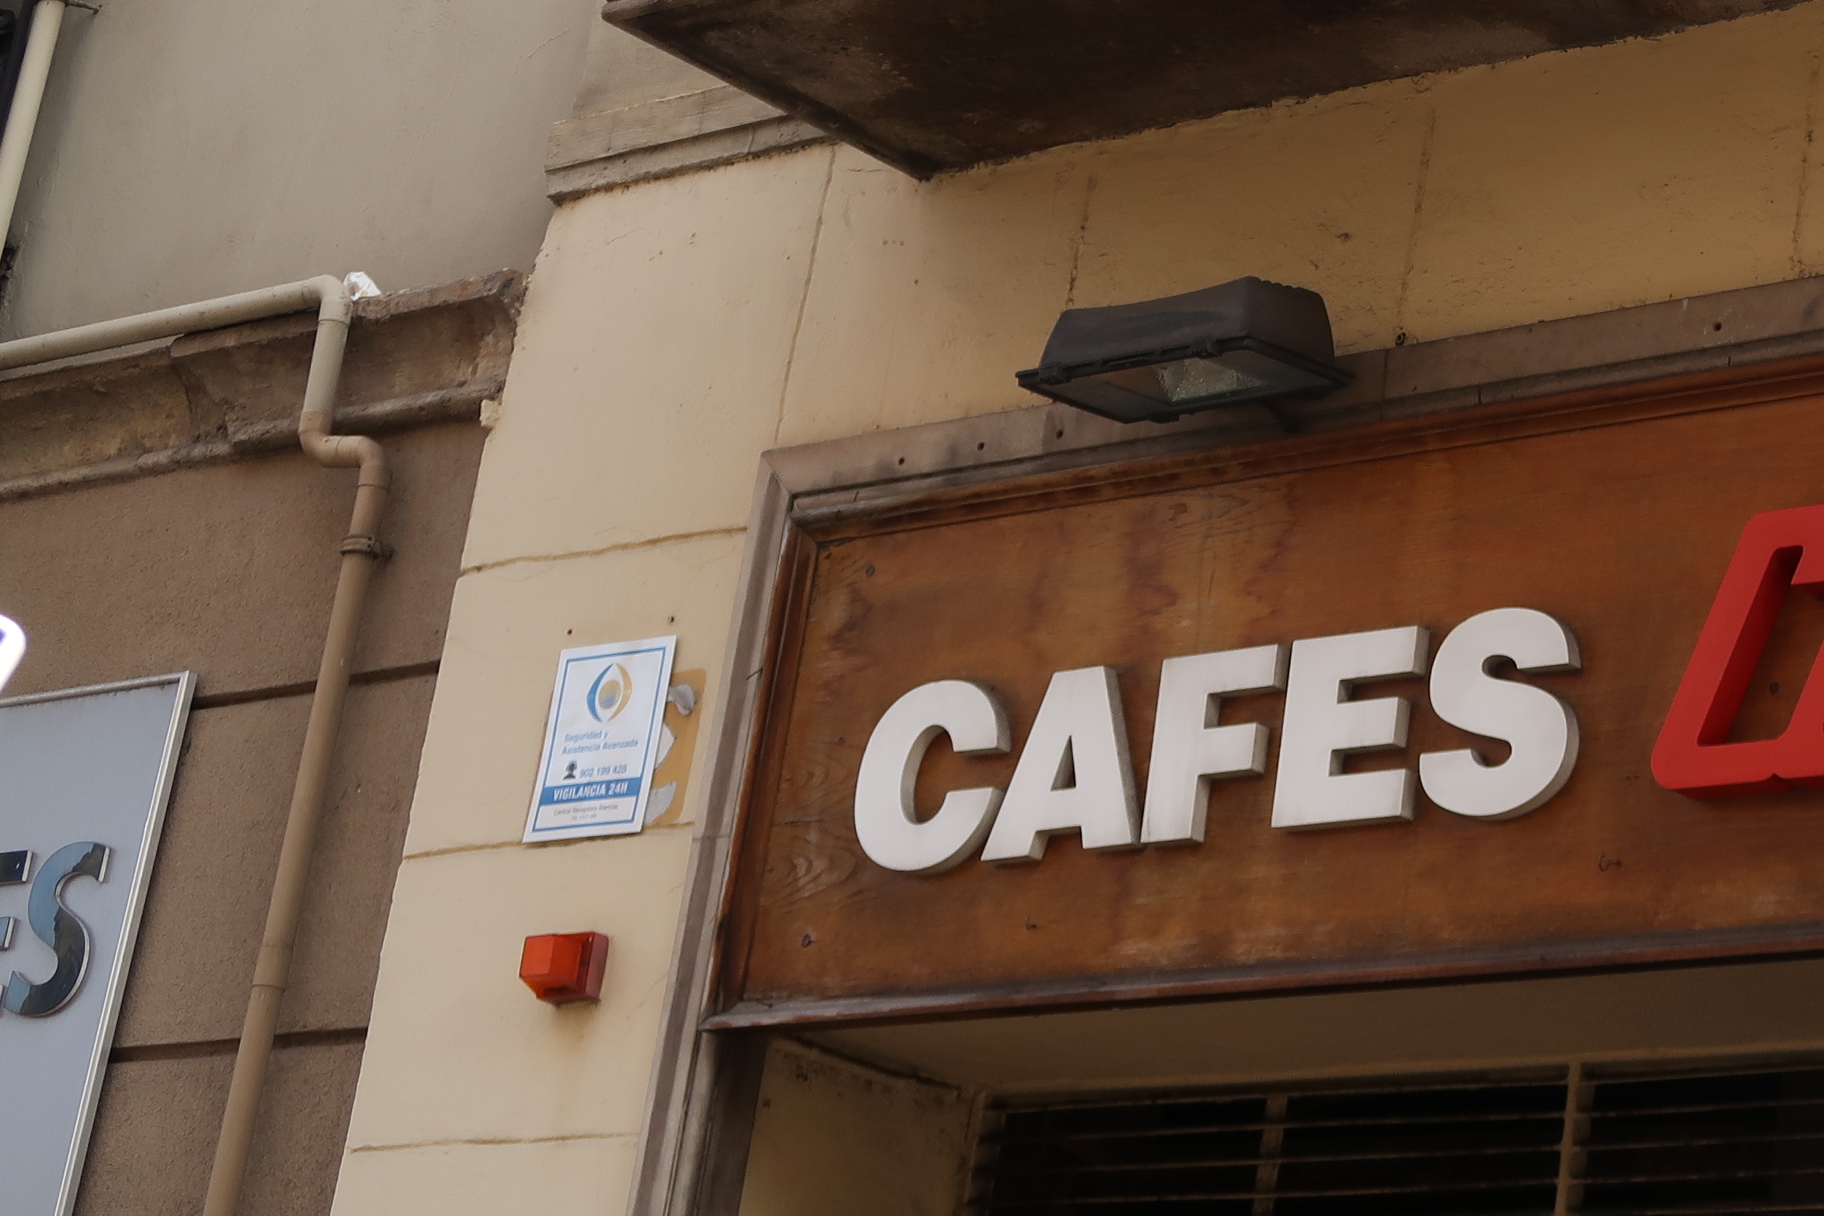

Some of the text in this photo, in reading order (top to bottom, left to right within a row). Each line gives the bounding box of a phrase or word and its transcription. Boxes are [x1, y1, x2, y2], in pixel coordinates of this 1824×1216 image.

[554, 782, 628, 800] VIGILANCIA 24H
[854, 606, 1582, 876] CAFES
